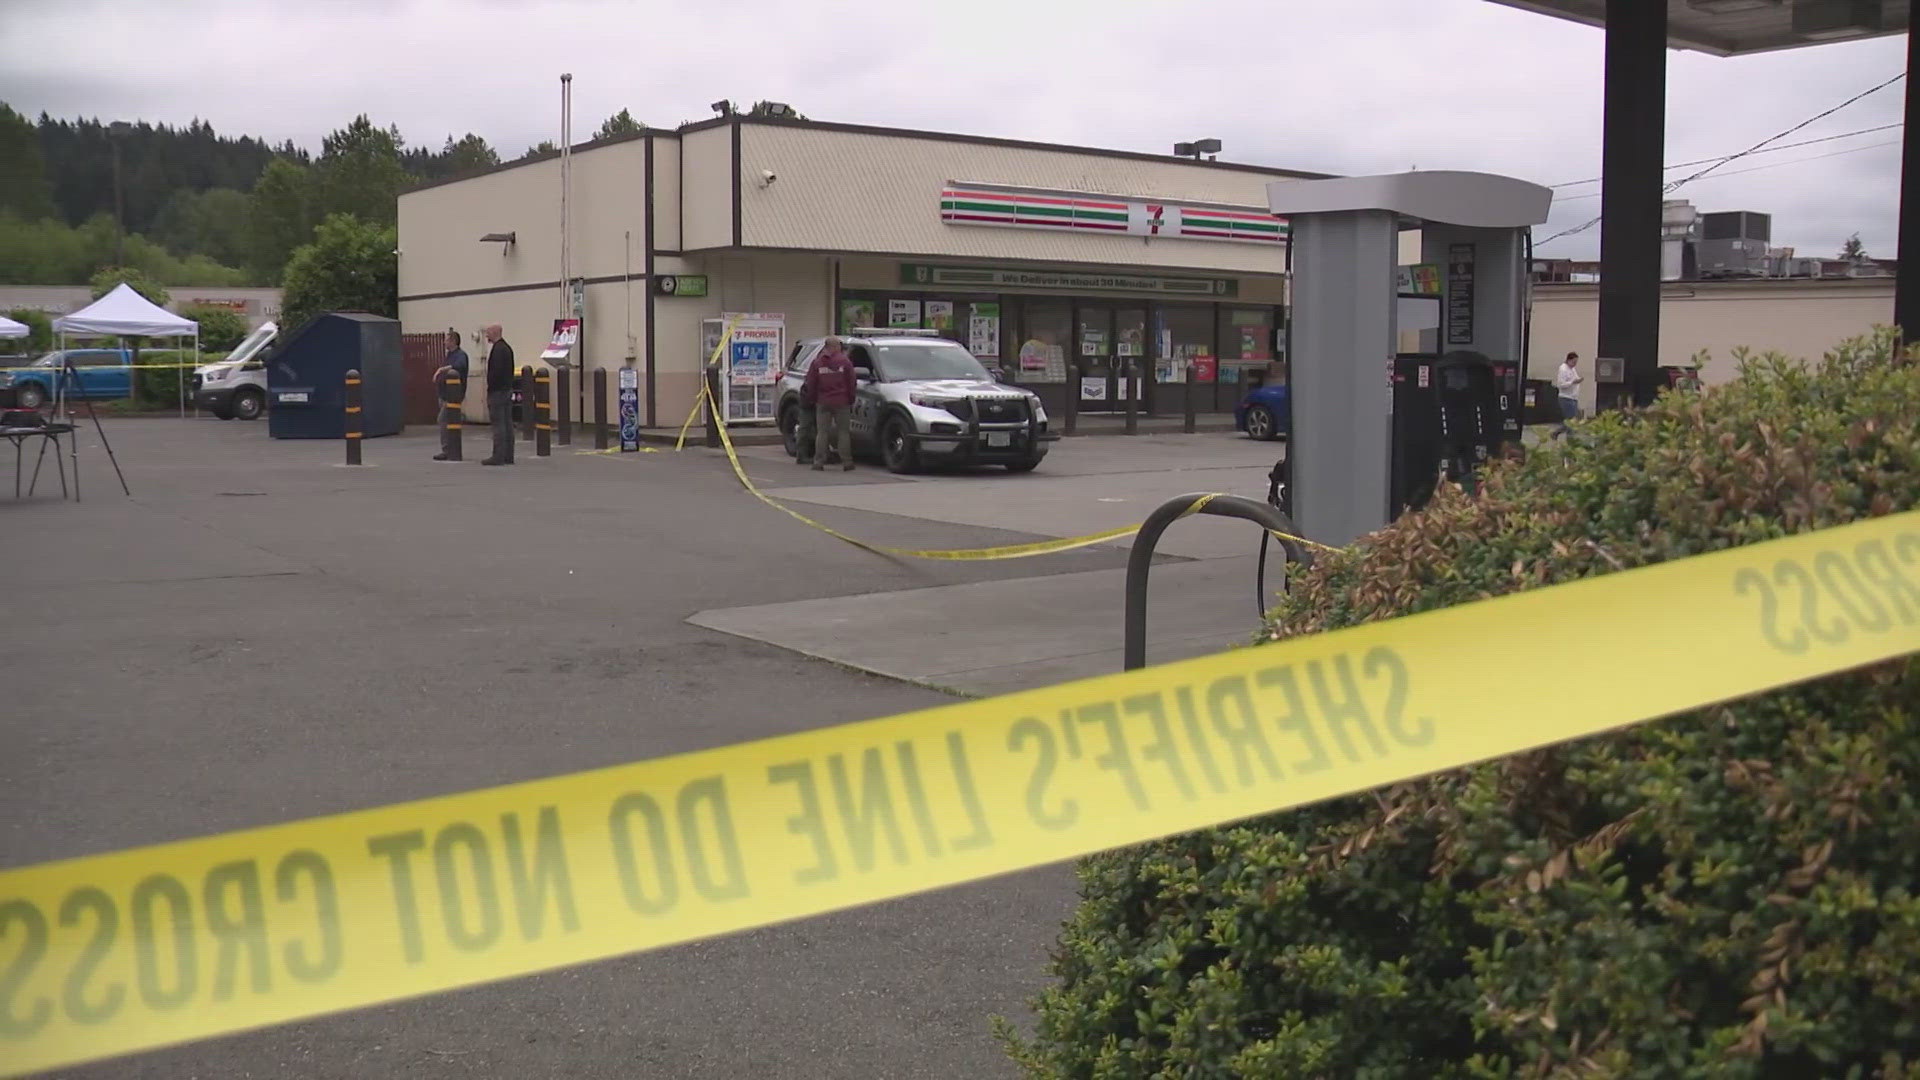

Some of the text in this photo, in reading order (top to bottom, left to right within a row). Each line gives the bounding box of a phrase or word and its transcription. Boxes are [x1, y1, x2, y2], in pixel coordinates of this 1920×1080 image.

[1002, 273, 1019, 283] We
[1020, 274, 1059, 285] Deliver
[1070, 277, 1100, 287] about
